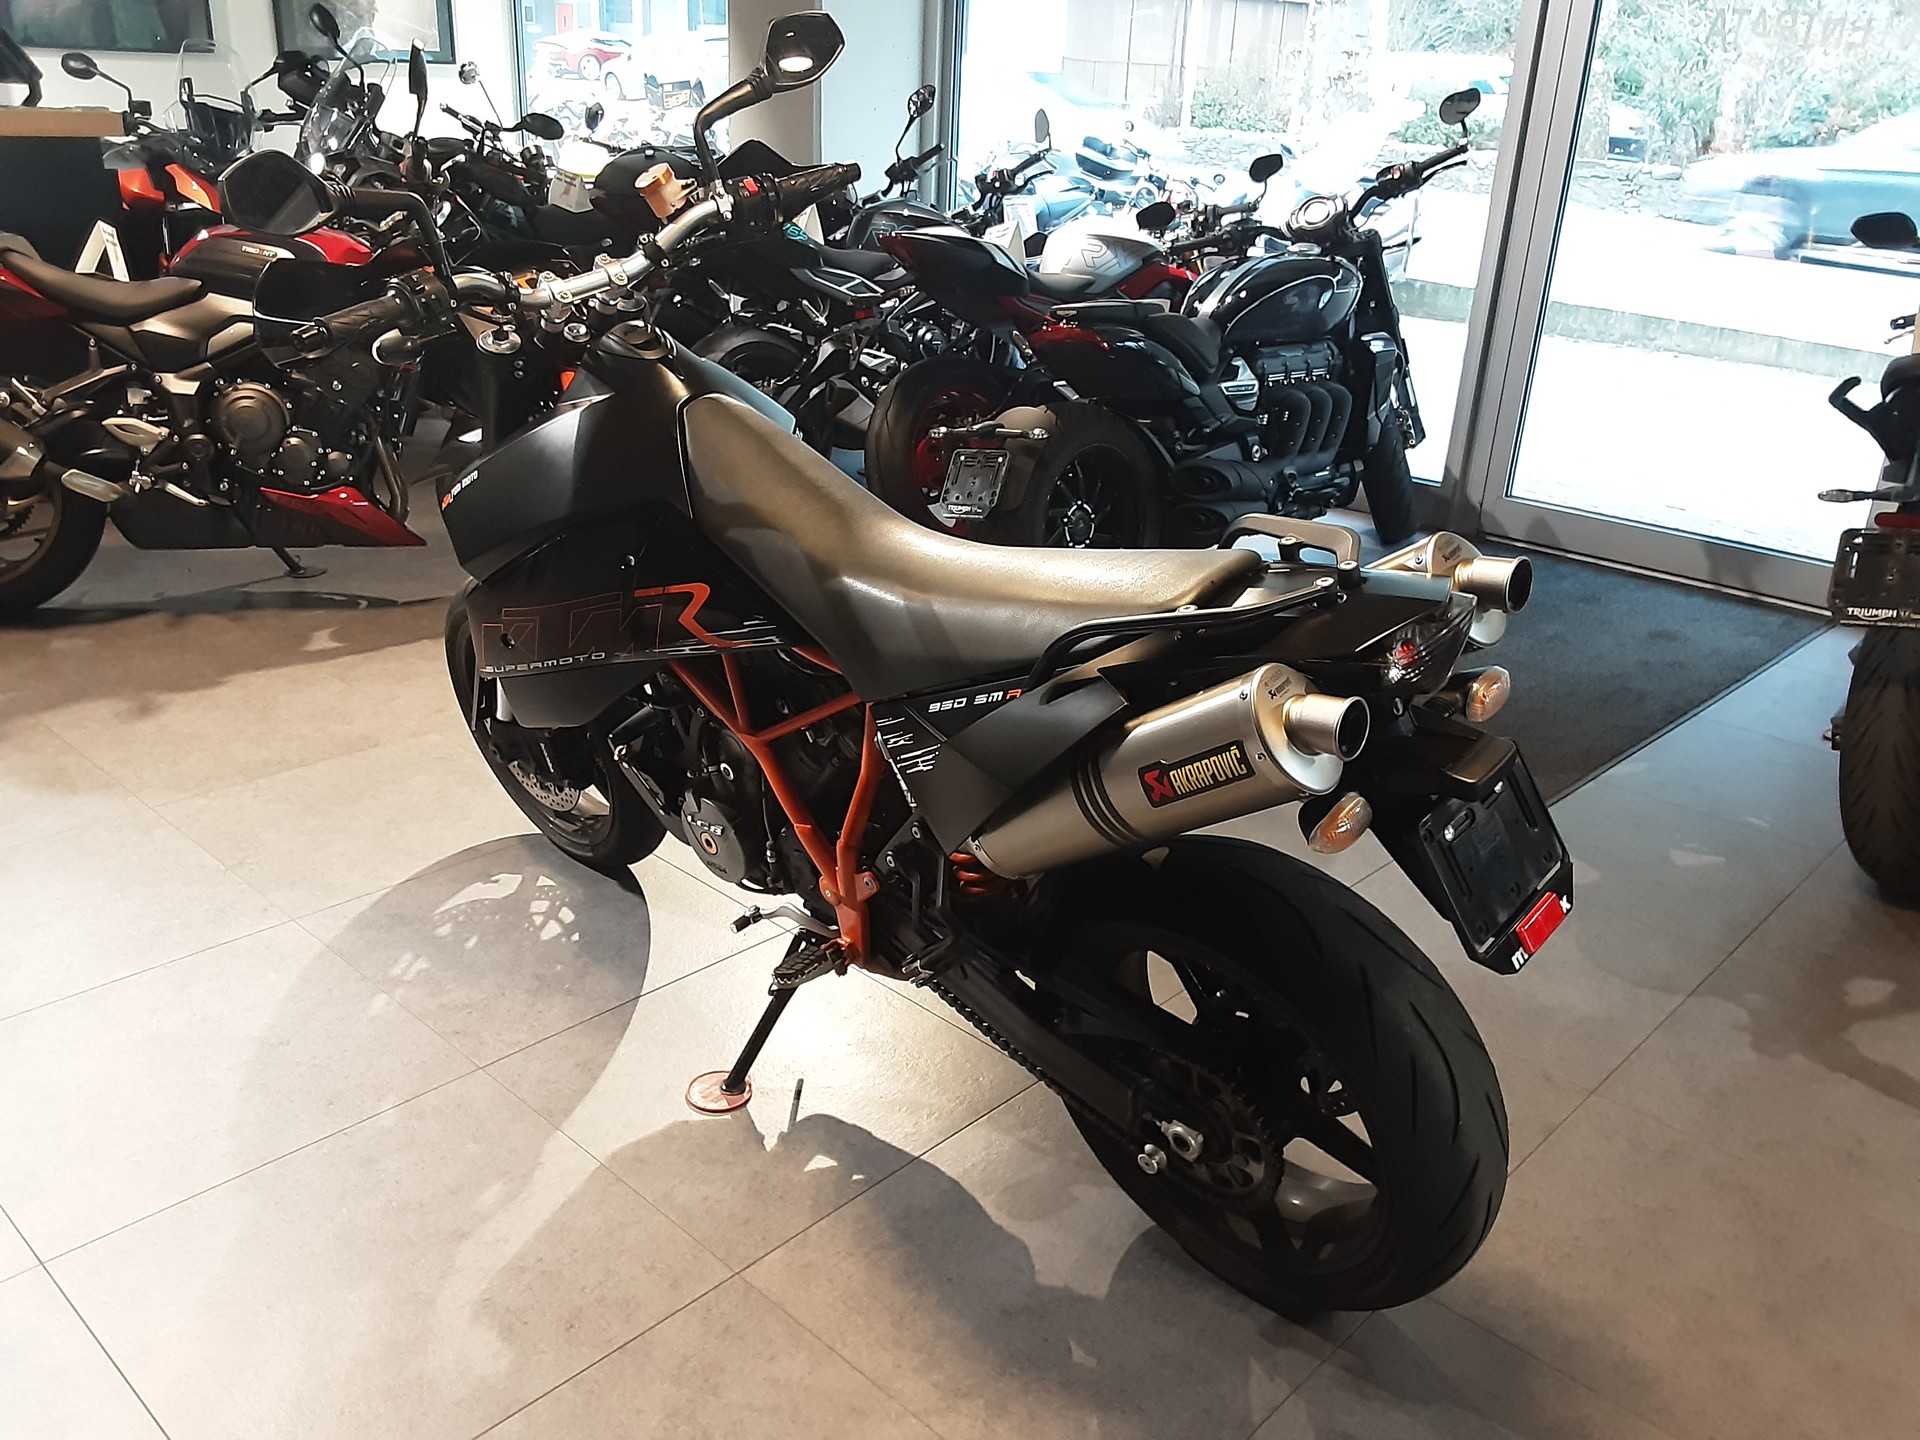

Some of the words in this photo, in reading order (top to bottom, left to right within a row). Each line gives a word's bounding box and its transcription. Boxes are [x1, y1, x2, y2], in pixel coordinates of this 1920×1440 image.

[1847, 607, 1897, 620] TRIUMPH
[480, 651, 606, 674] SUPERMOTO
[927, 697, 968, 713] 950
